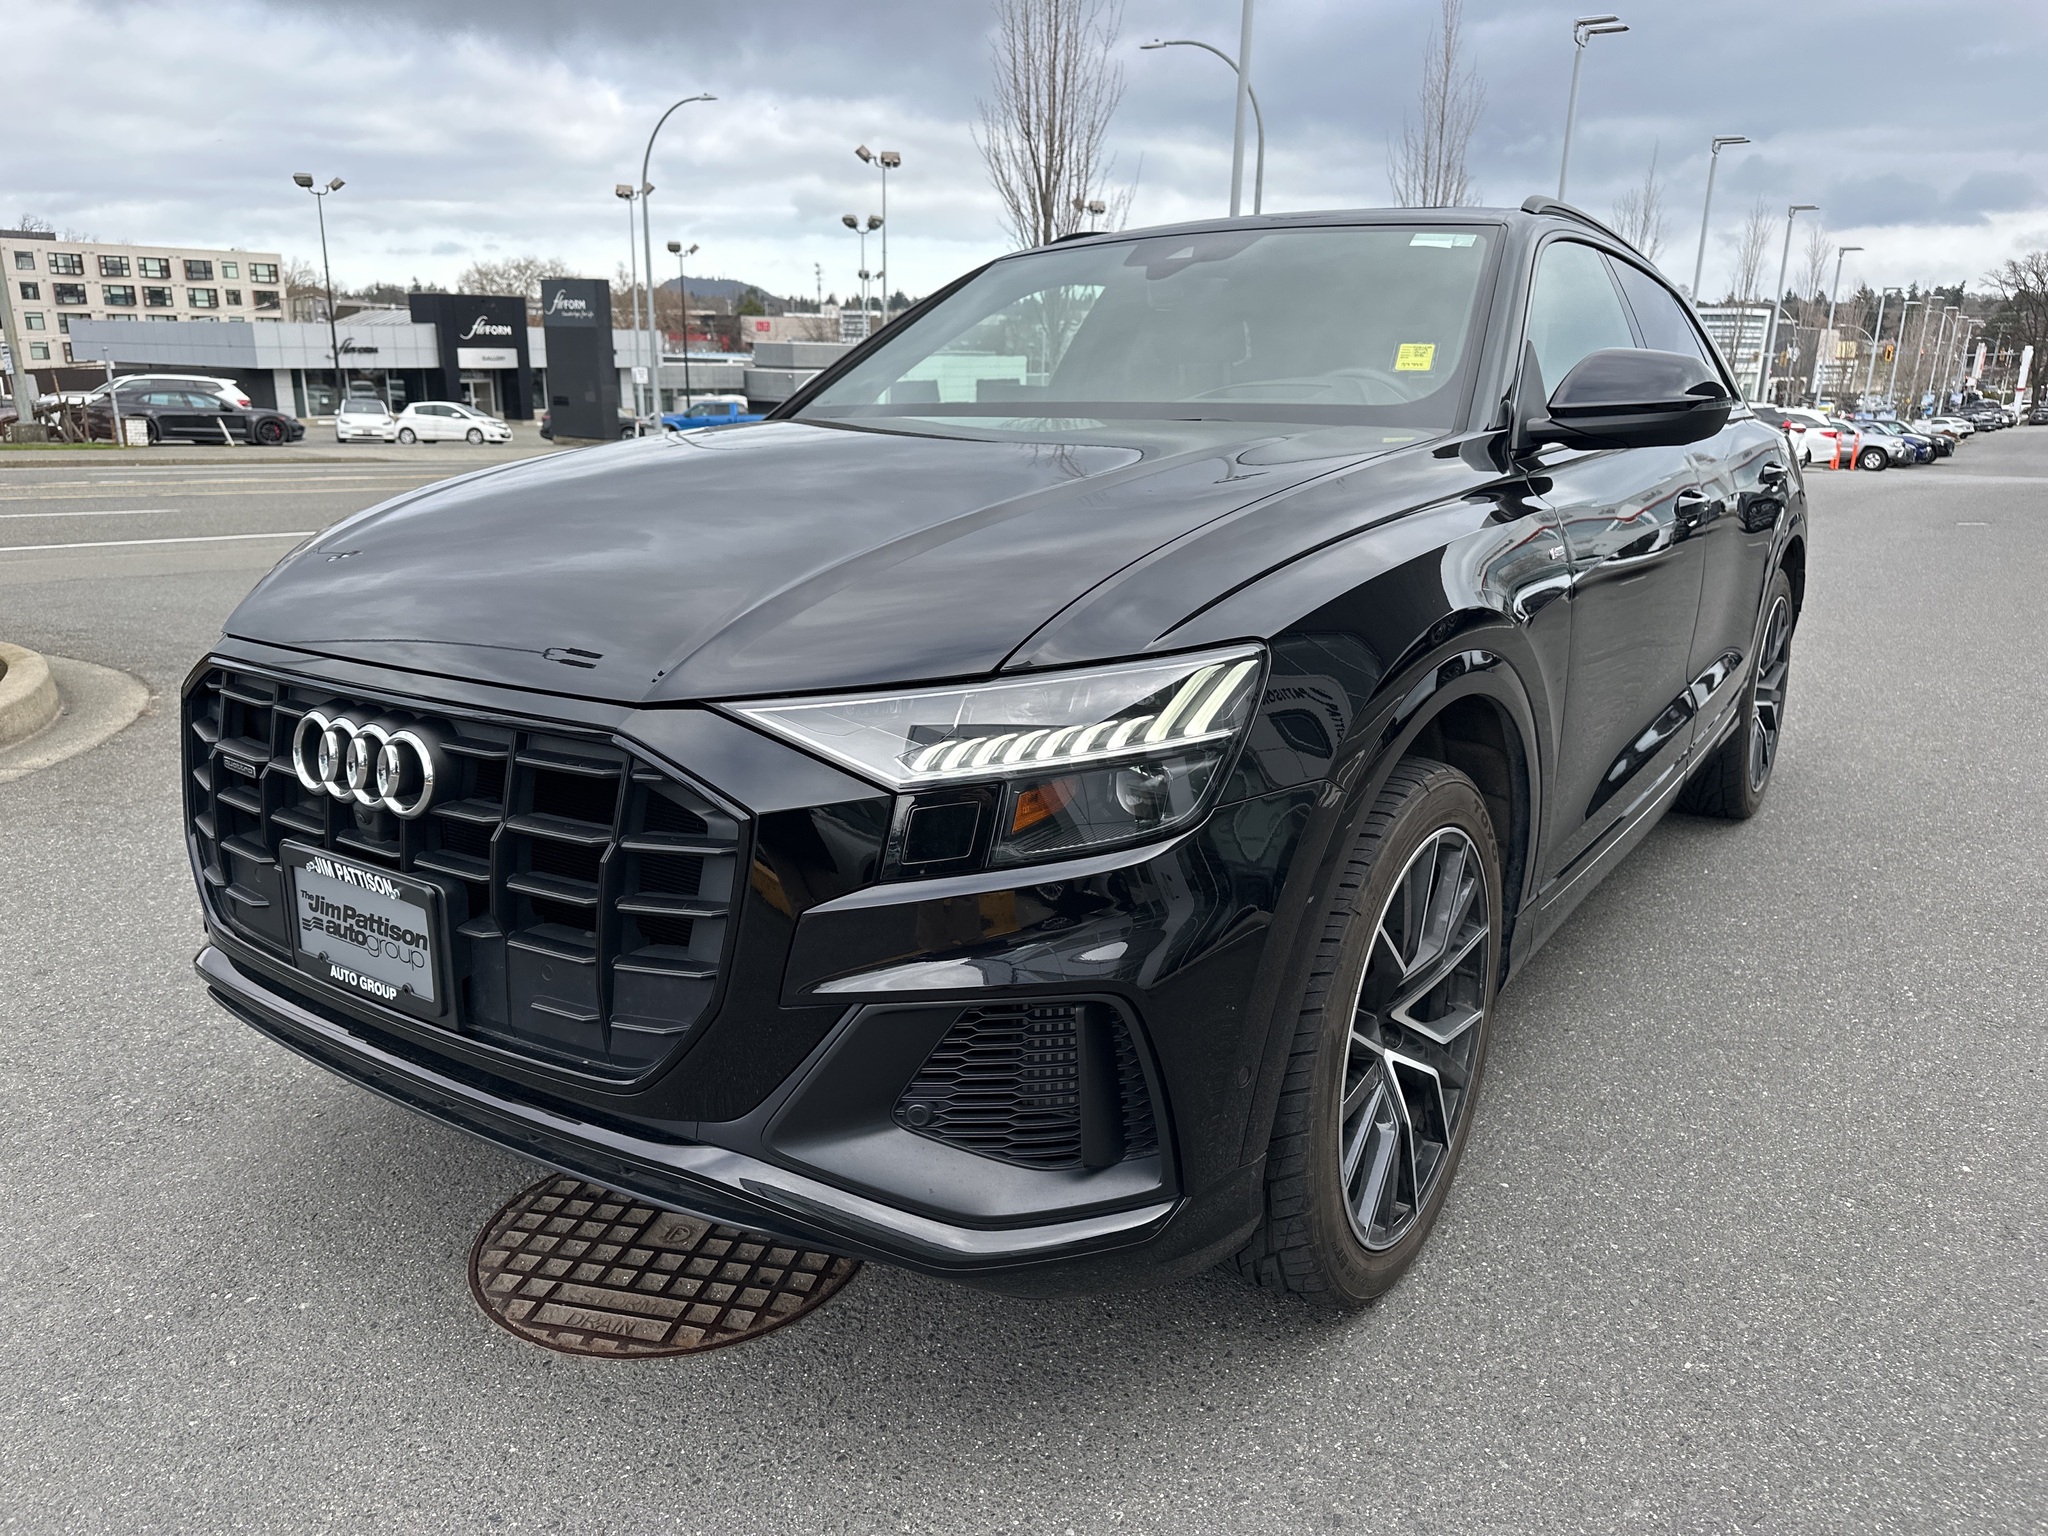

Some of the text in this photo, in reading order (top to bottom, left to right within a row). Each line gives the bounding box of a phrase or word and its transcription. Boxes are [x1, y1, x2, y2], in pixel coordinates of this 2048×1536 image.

[1473, 798, 1498, 864] TOYO
[313, 856, 393, 896] JIM PATTISON
[301, 889, 315, 901] The
[330, 965, 398, 1001] AUTO GROUP
[580, 1292, 658, 1314] STORM
[564, 1312, 637, 1336] DRAIN
